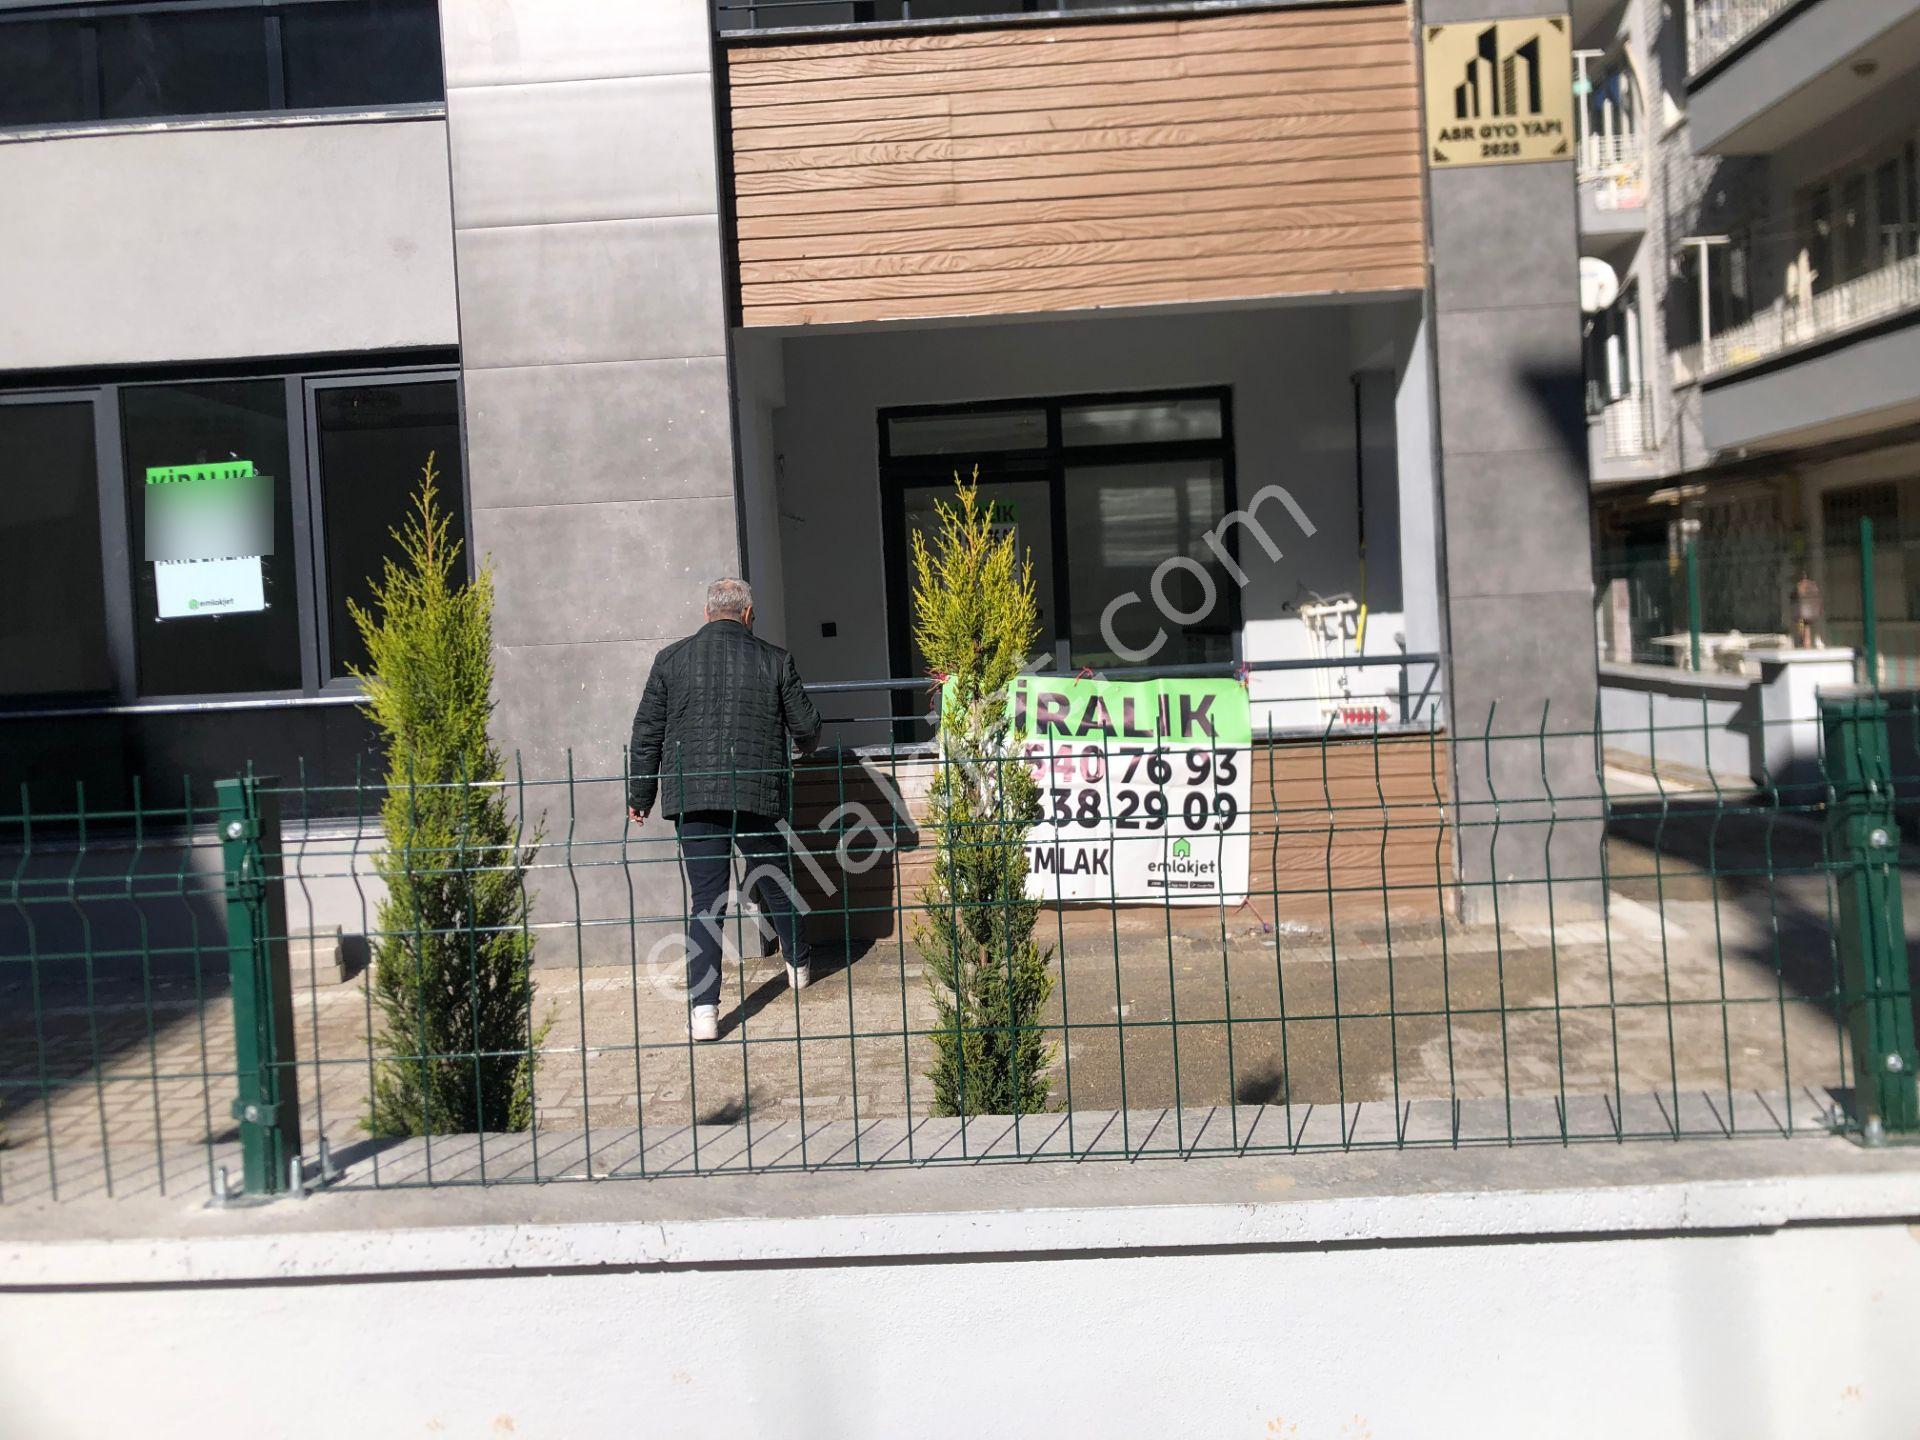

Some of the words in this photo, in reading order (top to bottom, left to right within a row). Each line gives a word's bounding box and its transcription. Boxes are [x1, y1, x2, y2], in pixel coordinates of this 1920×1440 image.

[1013, 680, 1220, 738] İRALIK
[1119, 746, 1172, 785] 76
[1185, 747, 1238, 786] 93
[1114, 789, 1169, 831] 29
[1183, 791, 1238, 831] 09
[1147, 859, 1216, 877] emlakjet
